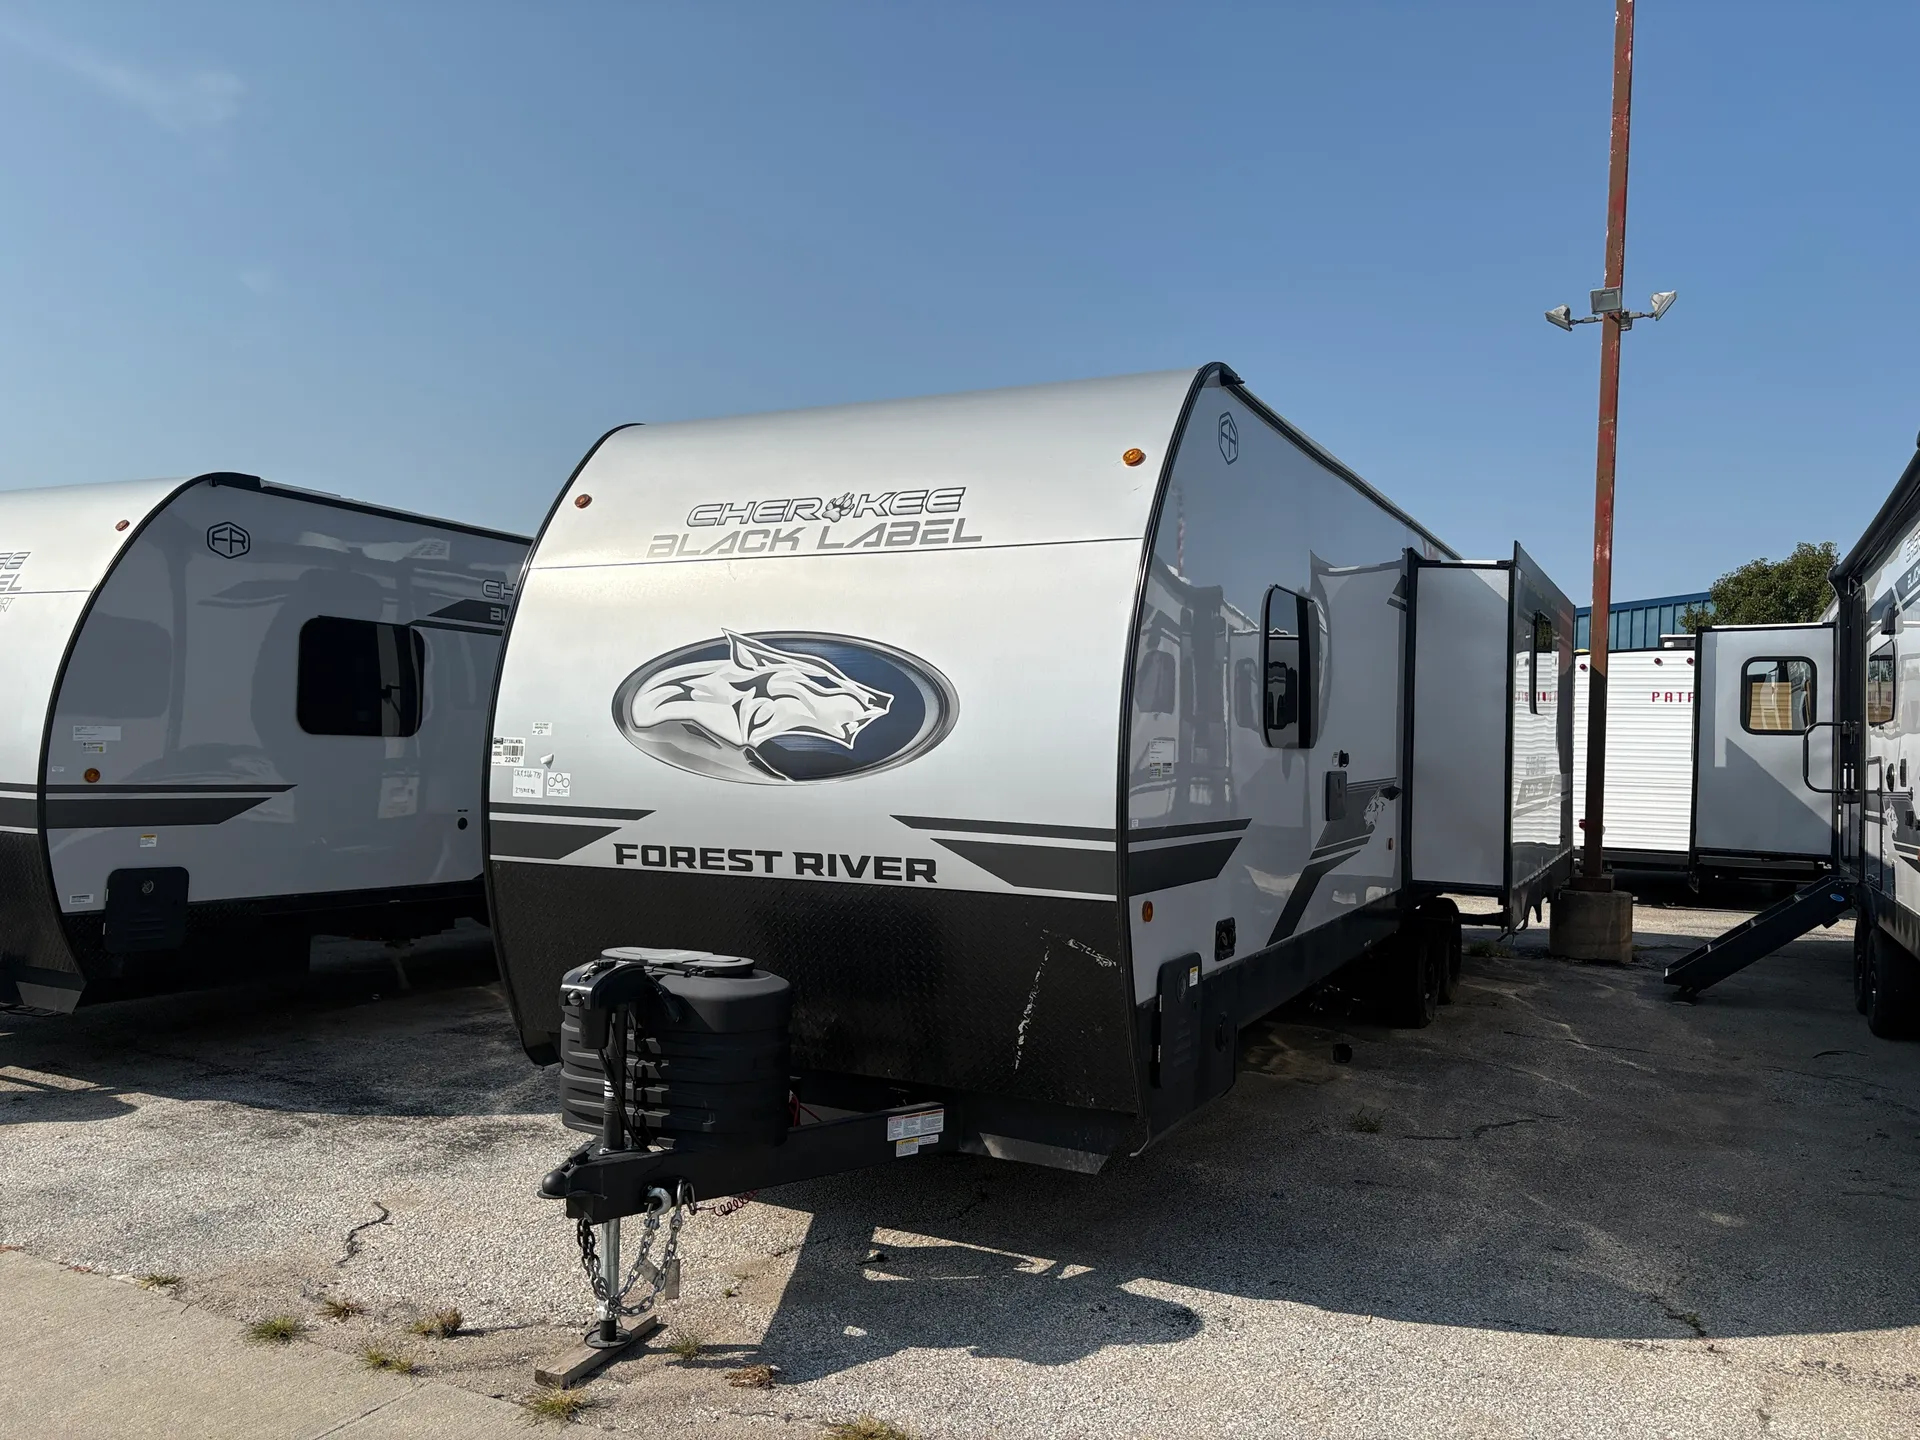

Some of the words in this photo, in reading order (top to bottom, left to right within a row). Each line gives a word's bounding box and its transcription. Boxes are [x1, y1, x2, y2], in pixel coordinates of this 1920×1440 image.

[646, 527, 807, 559] BLACK
[816, 517, 983, 550] LABEL
[612, 842, 783, 873] FOREST
[792, 851, 938, 884] RIVER
